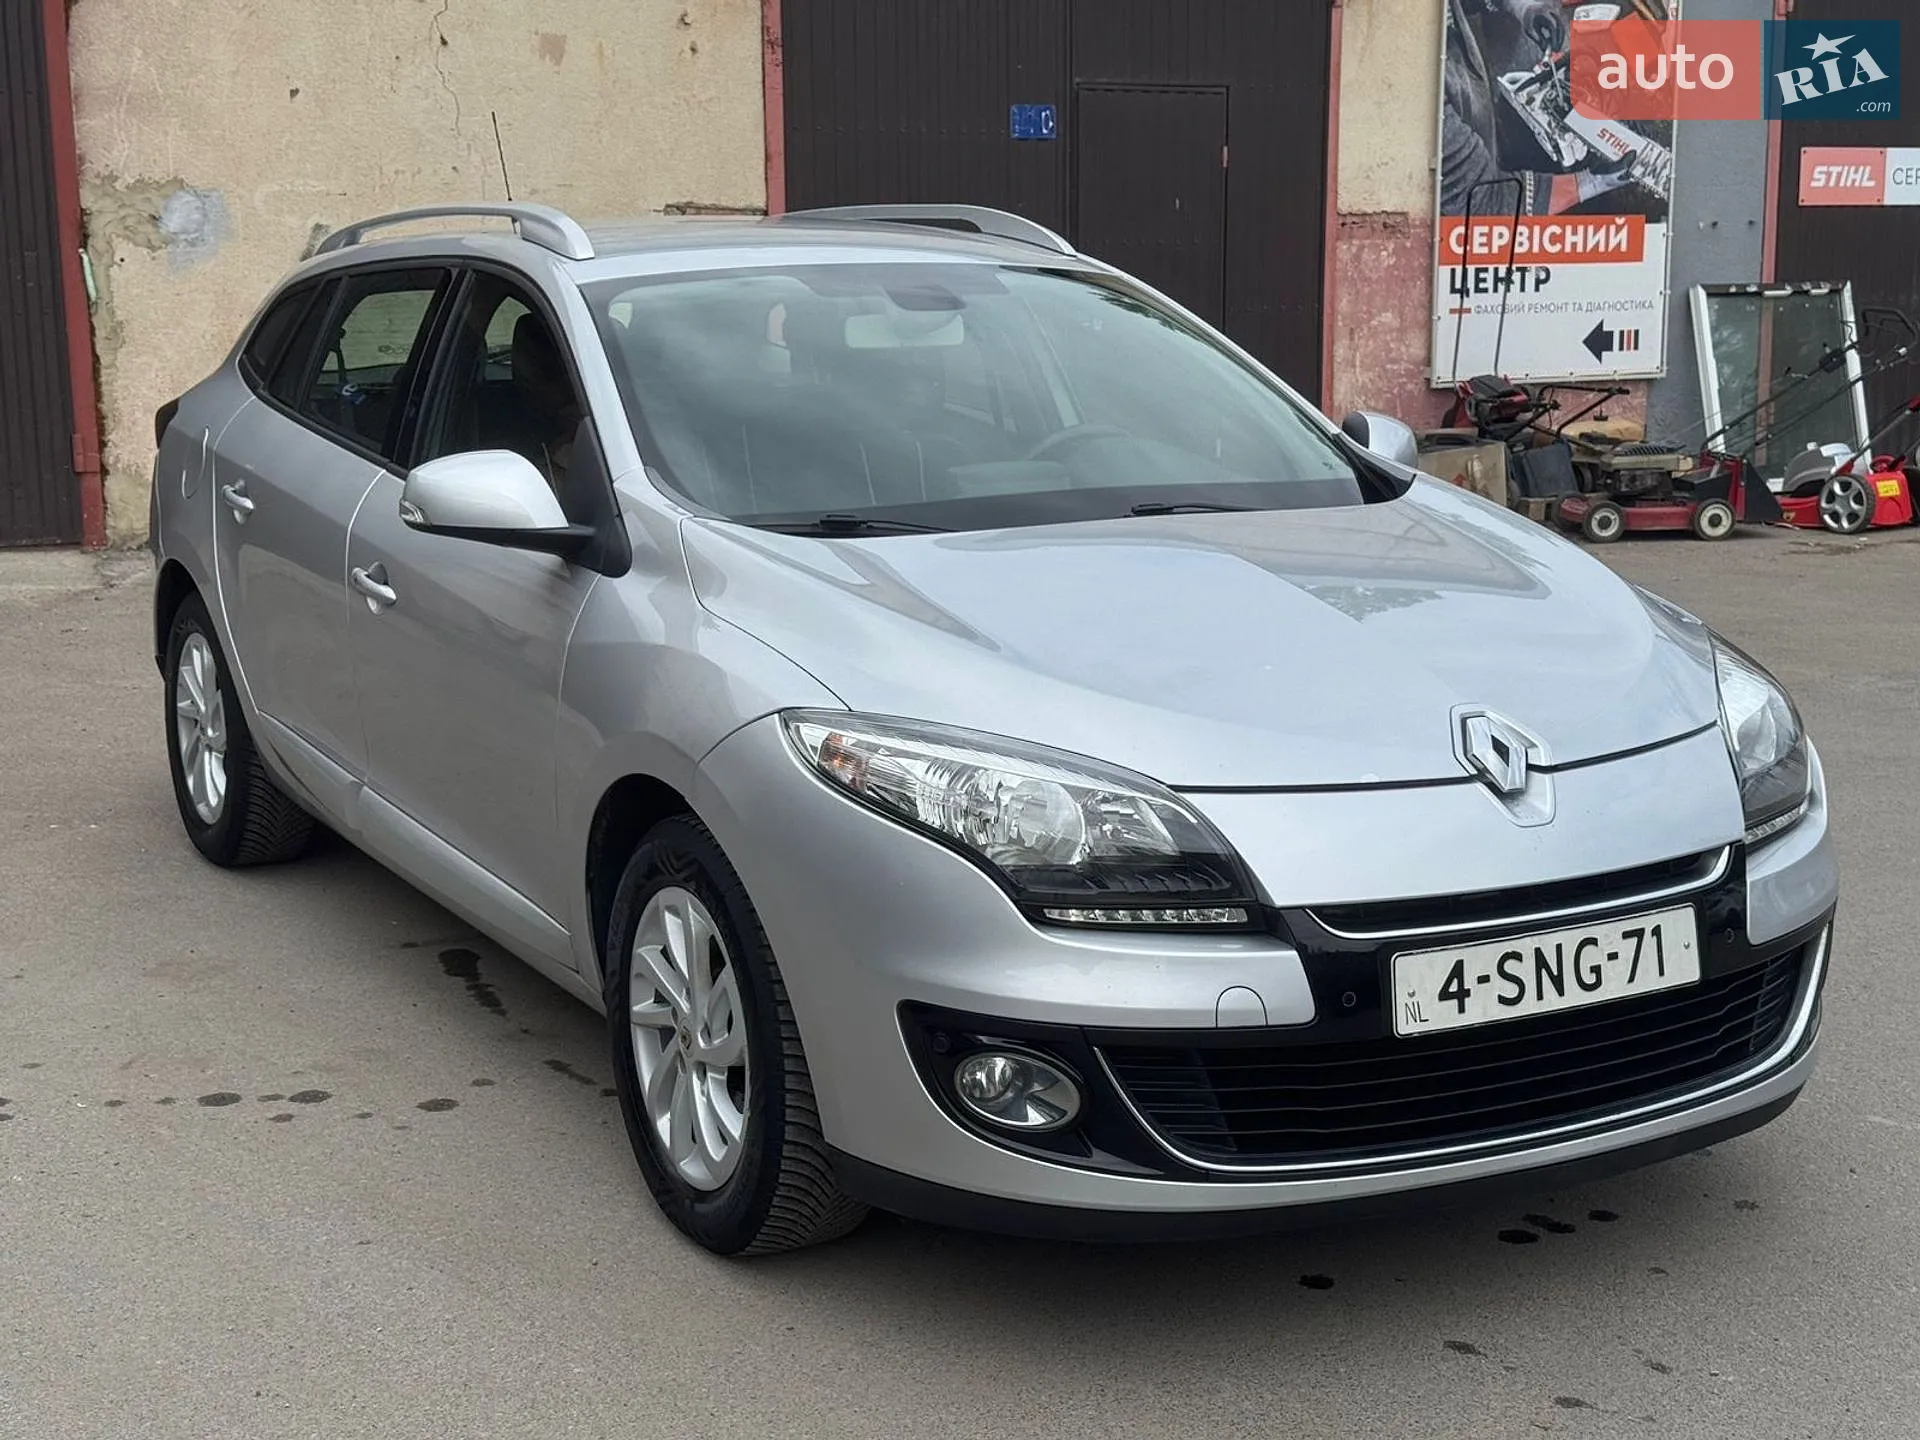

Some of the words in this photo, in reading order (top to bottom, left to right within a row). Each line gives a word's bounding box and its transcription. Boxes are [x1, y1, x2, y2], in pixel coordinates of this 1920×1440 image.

[1810, 165, 1877, 187] STIHL
[1450, 217, 1629, 255] СЕРВІСНИЙ
[1450, 266, 1552, 298] ЦЕНТР
[1474, 302, 1526, 315] ФАХОВИЙ
[1528, 302, 1568, 313] РЕМОНТ
[1572, 302, 1583, 312] ТА
[1585, 300, 1654, 313] ДІАГНОСТИКА
[1438, 924, 1665, 1014] 4-SNG-71
[1405, 1000, 1429, 1025] NL
